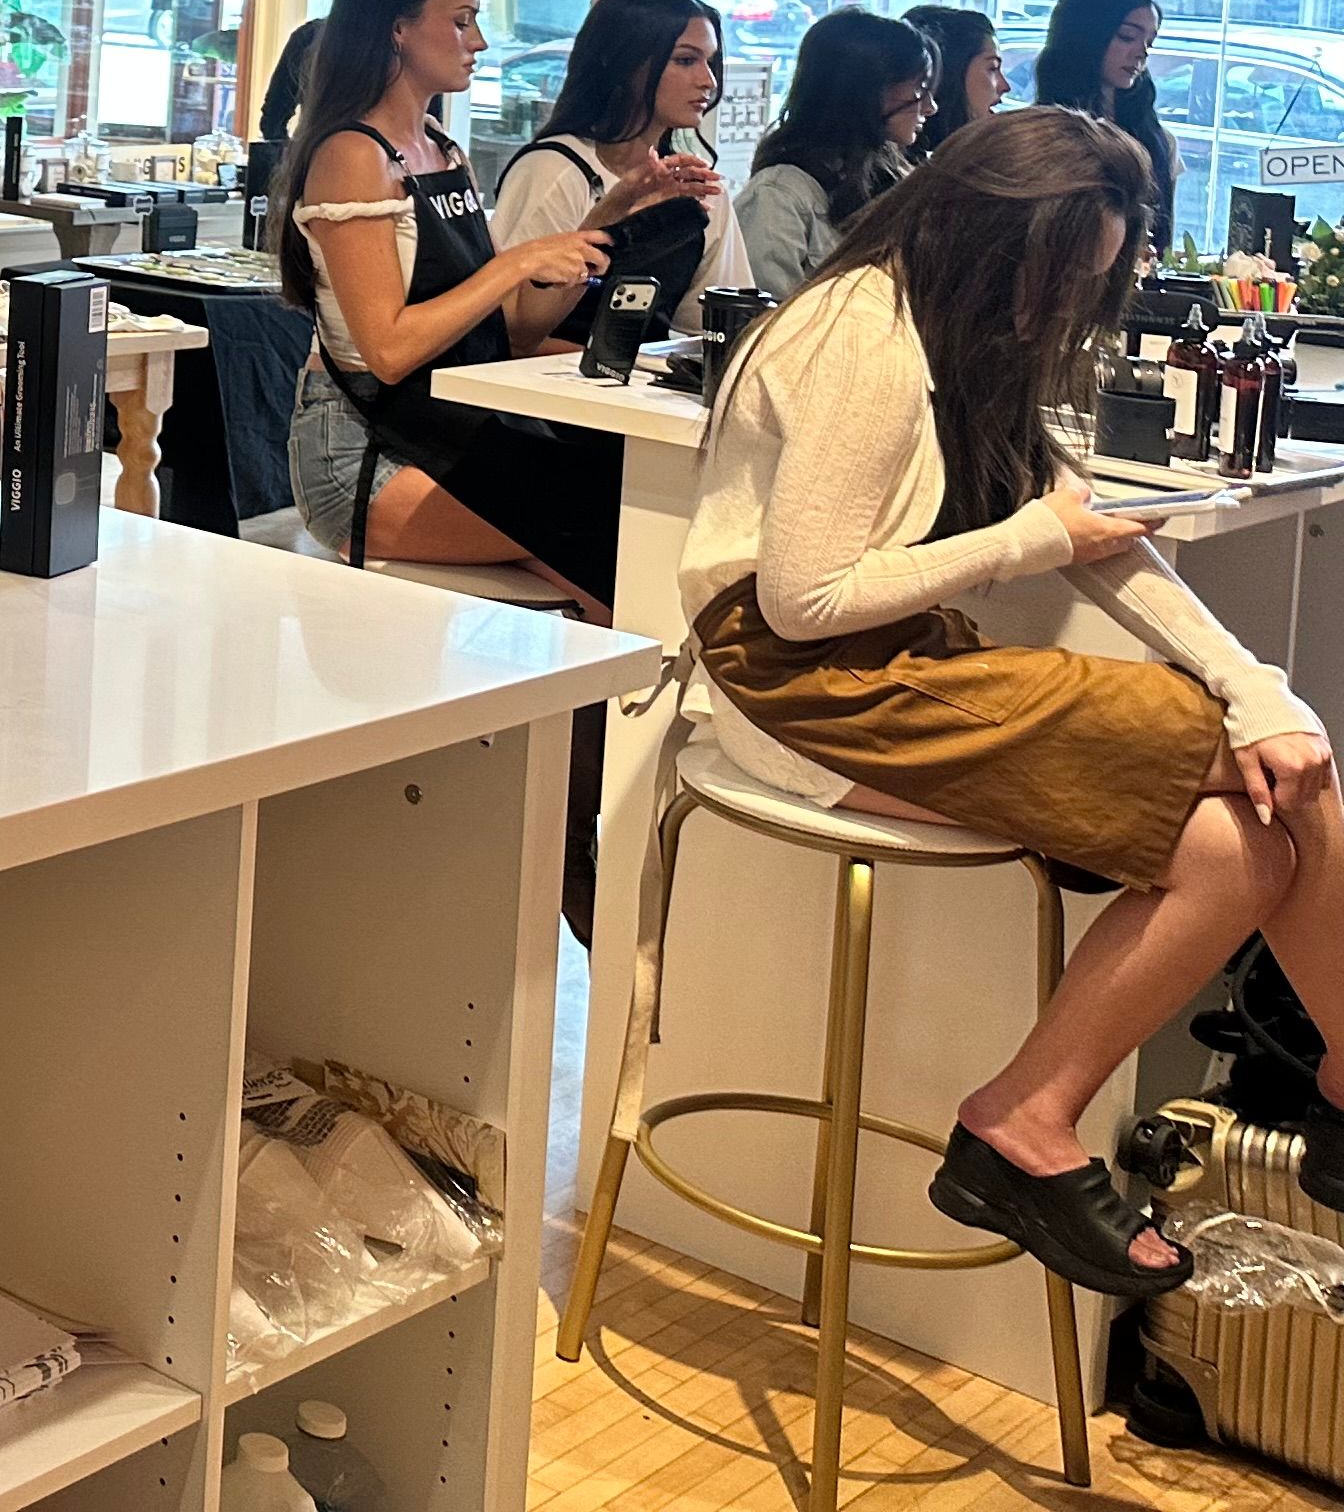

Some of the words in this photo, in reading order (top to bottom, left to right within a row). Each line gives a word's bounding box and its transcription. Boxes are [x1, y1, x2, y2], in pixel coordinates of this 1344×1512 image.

[1267, 154, 1344, 177] OPEN
[17, 341, 25, 358] Tool
[11, 468, 22, 511] VIGGIO
